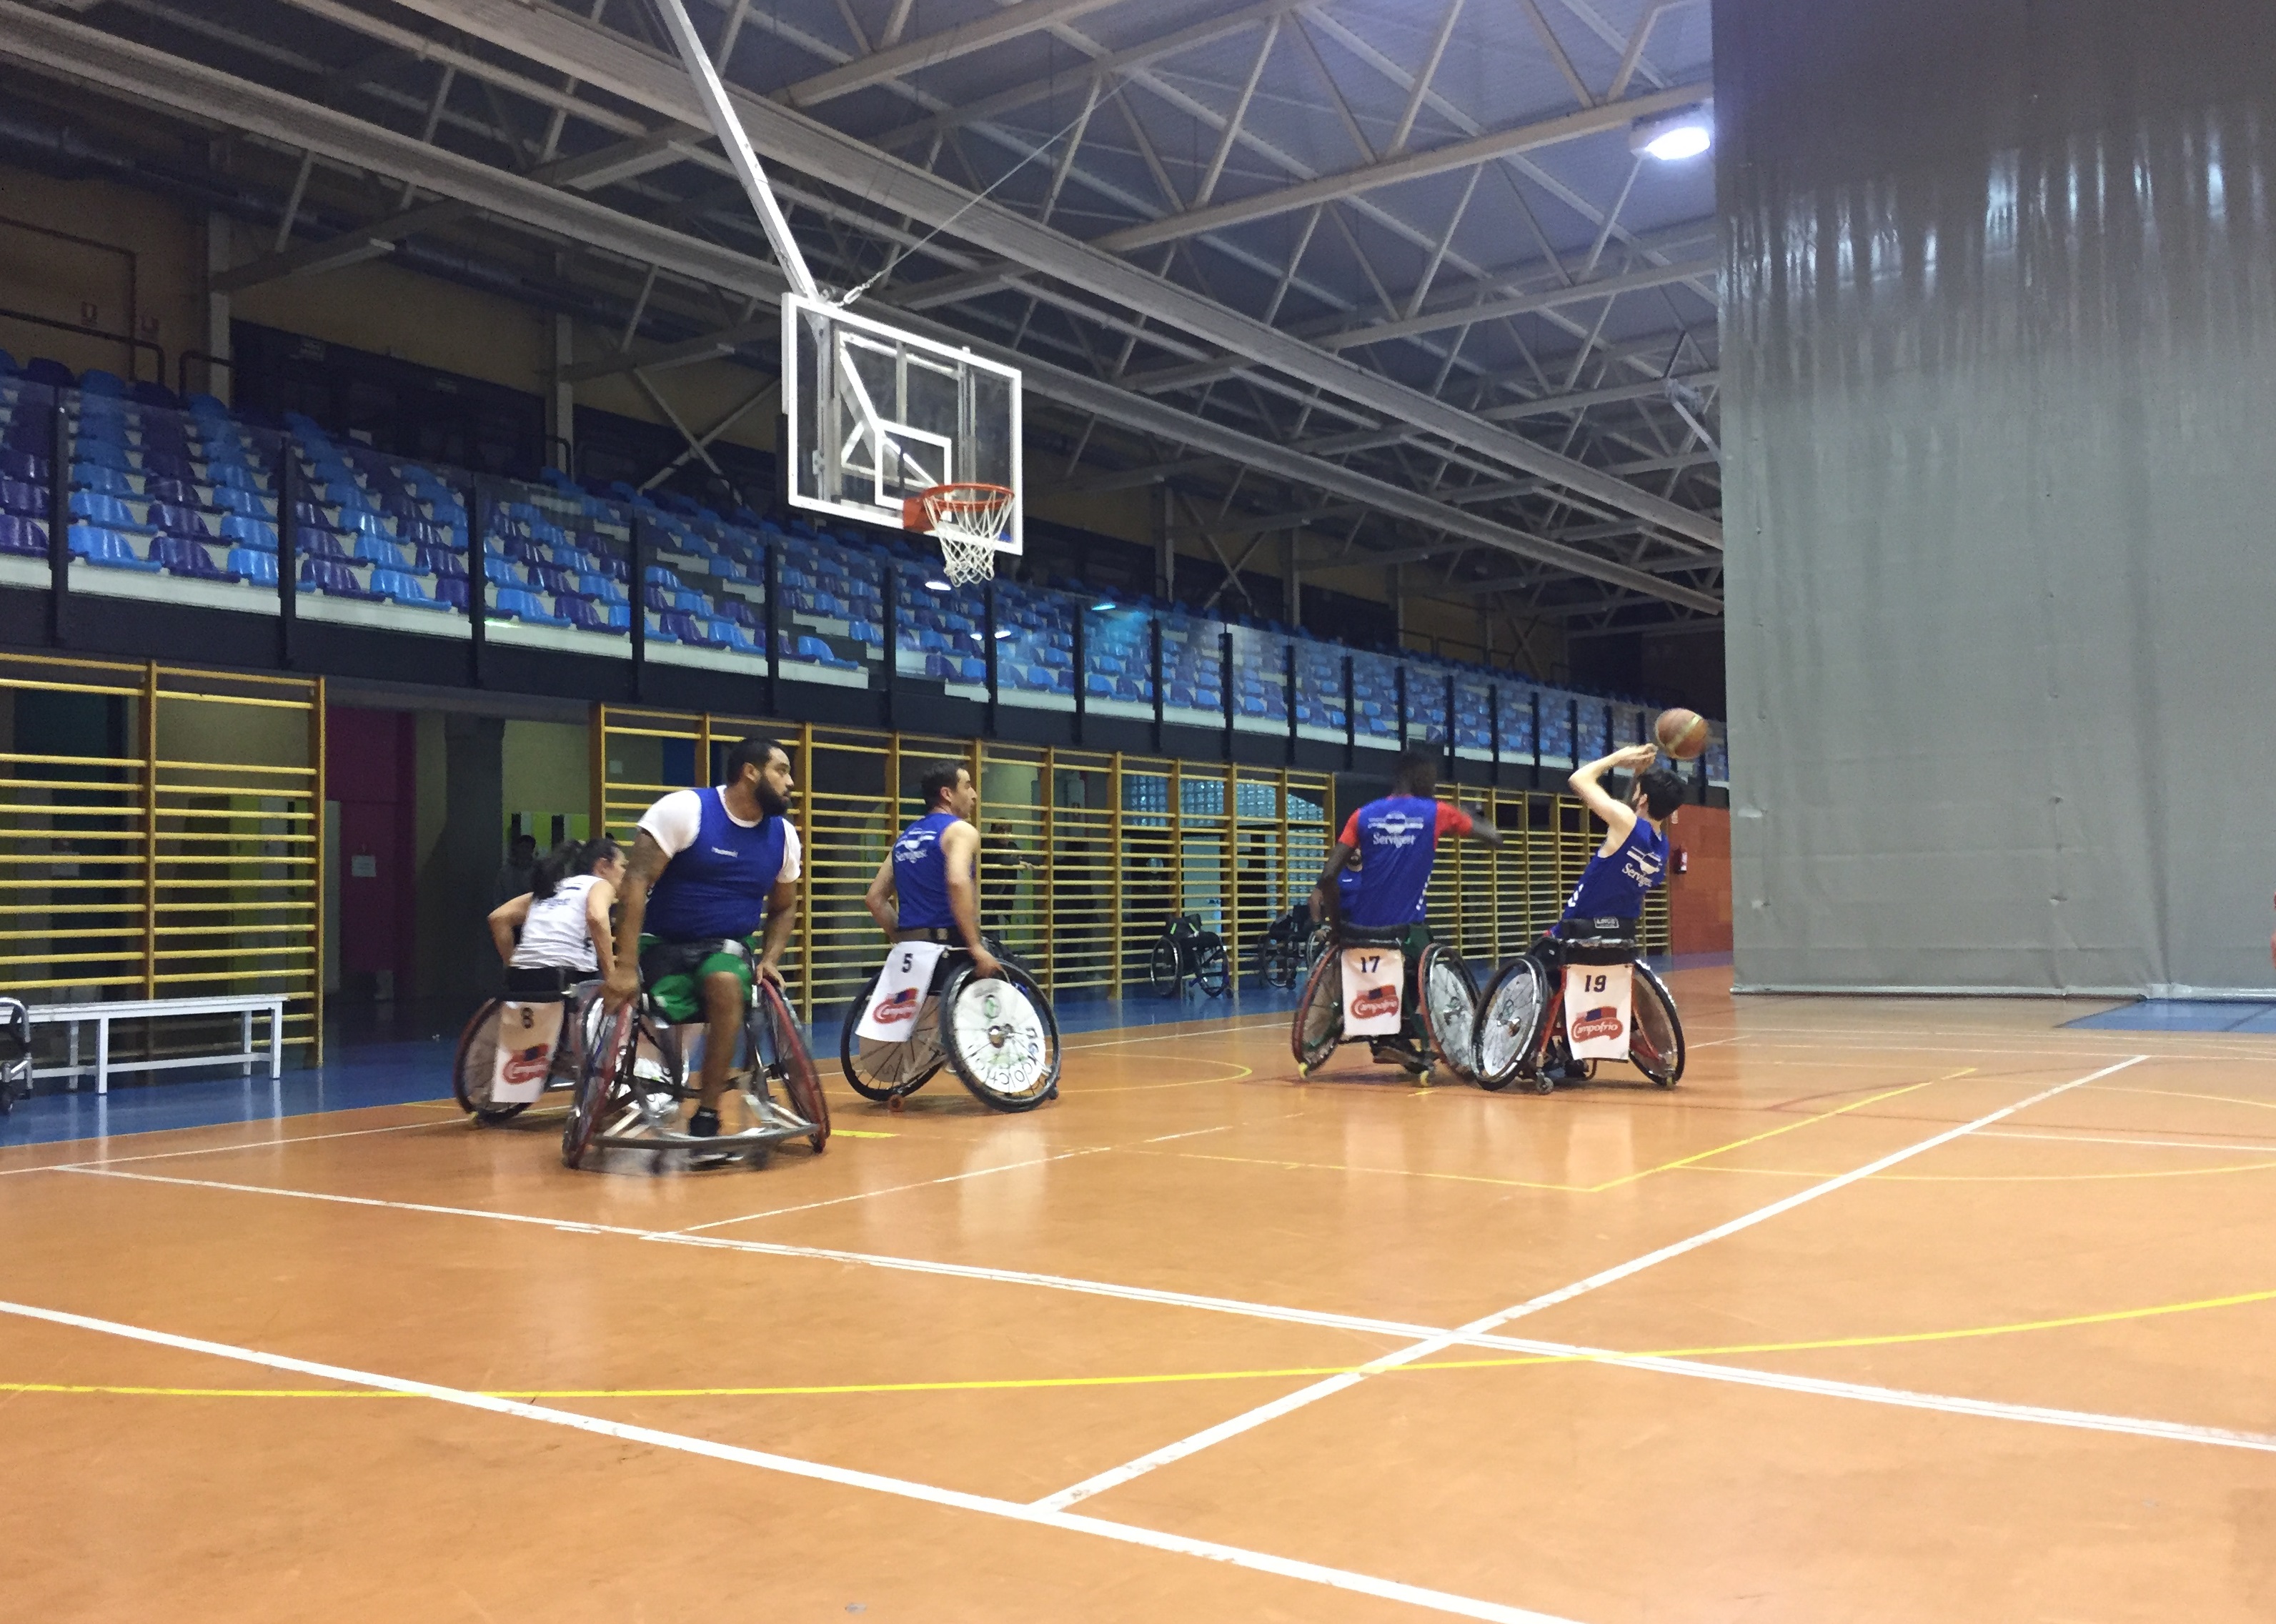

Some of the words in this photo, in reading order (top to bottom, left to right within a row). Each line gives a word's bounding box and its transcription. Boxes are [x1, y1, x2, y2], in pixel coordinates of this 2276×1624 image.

[902, 953, 913, 973] 5
[1361, 956, 1380, 973] 17
[1584, 975, 1606, 992] 19
